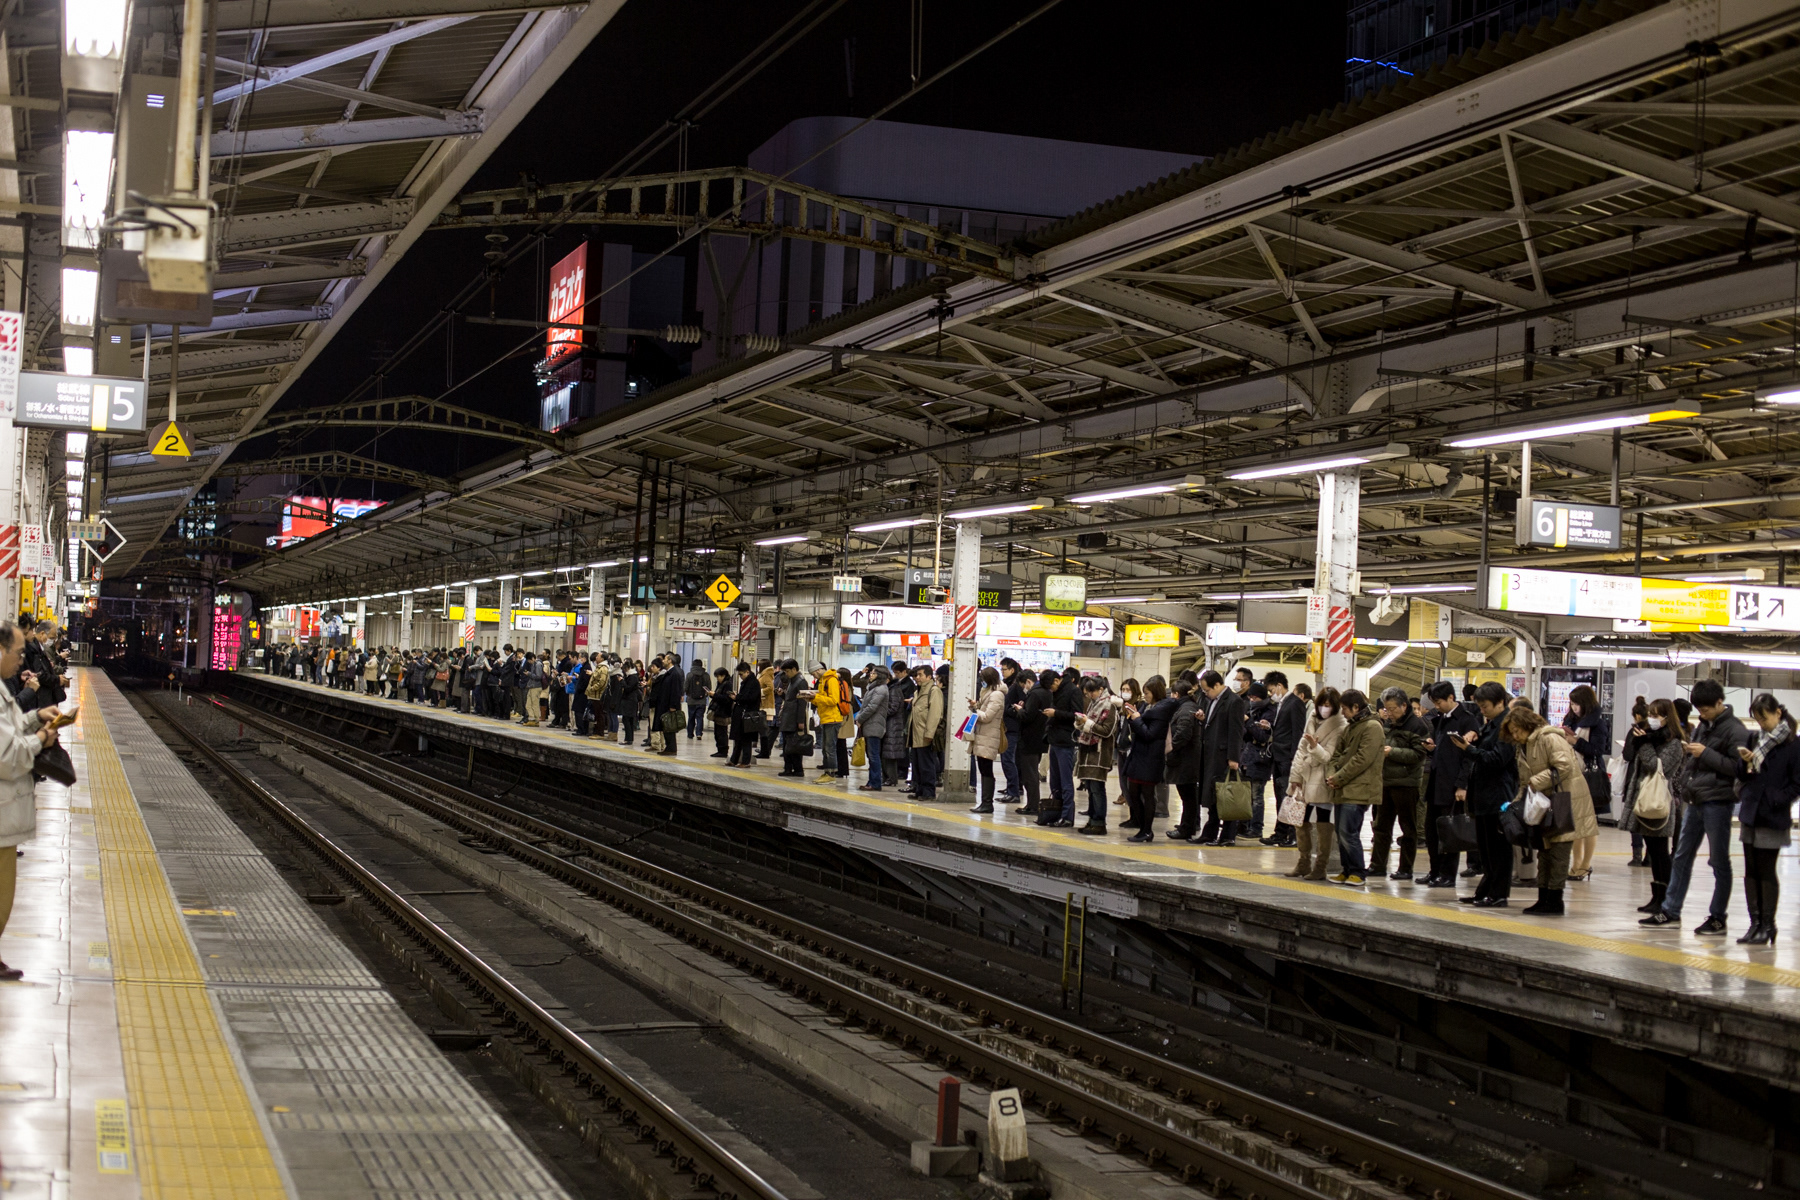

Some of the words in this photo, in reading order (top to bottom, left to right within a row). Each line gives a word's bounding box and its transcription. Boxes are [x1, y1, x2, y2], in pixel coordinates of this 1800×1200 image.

[550, 266, 584, 322] カラオケ
[112, 386, 134, 421] 5
[165, 435, 178, 451] 2
[1536, 507, 1554, 536] 6
[913, 571, 920, 582] 6
[1512, 574, 1520, 590] 3
[1580, 580, 1588, 595] 4
[90, 584, 97, 595] 5
[522, 598, 530, 608] 6
[668, 618, 718, 628] ライナー券うりば
[998, 1097, 1018, 1116] 8
